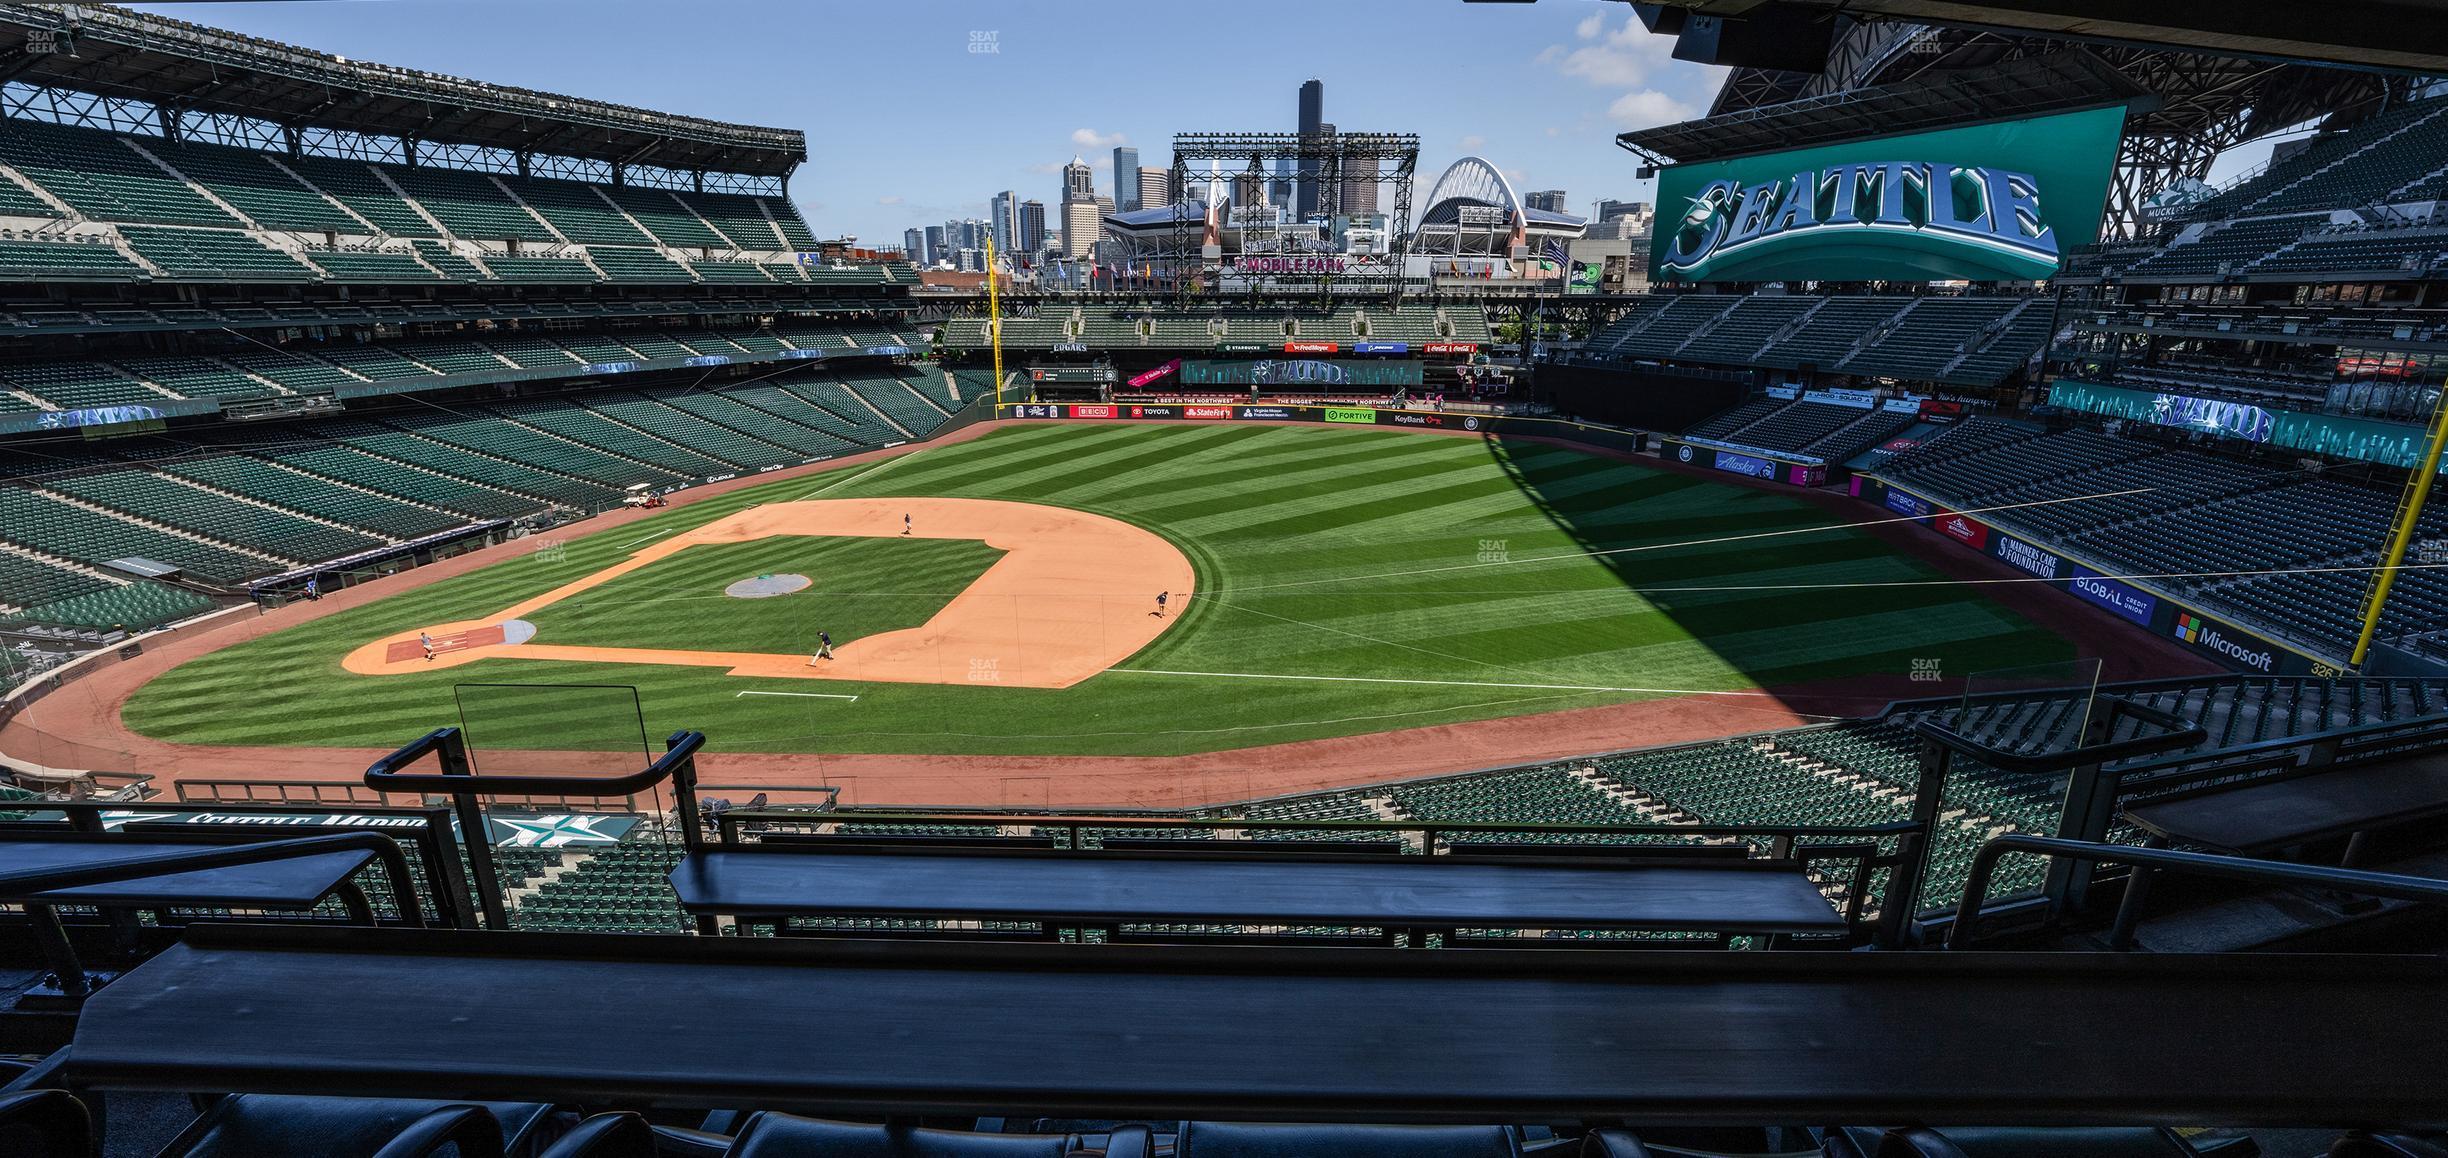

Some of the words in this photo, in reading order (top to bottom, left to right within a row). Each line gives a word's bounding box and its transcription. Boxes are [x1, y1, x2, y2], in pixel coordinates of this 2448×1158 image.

[1660, 162, 2059, 272] SEATTLE
[1301, 236, 1338, 252] MARINERS
[1307, 258, 1345, 272] PARK
[1080, 408, 1107, 416] BECU
[1395, 415, 1425, 424] KeyBank
[1718, 455, 1755, 473] Alaska
[2009, 539, 2039, 561] MARINERS
[2040, 552, 2058, 568] CARE
[2007, 549, 2055, 580] FOUNDATION
[2076, 575, 2122, 606] GLOBAL
[2123, 603, 2144, 616] UNION
[2125, 596, 2147, 610] CREDIT
[2200, 627, 2272, 673] Microsoft
